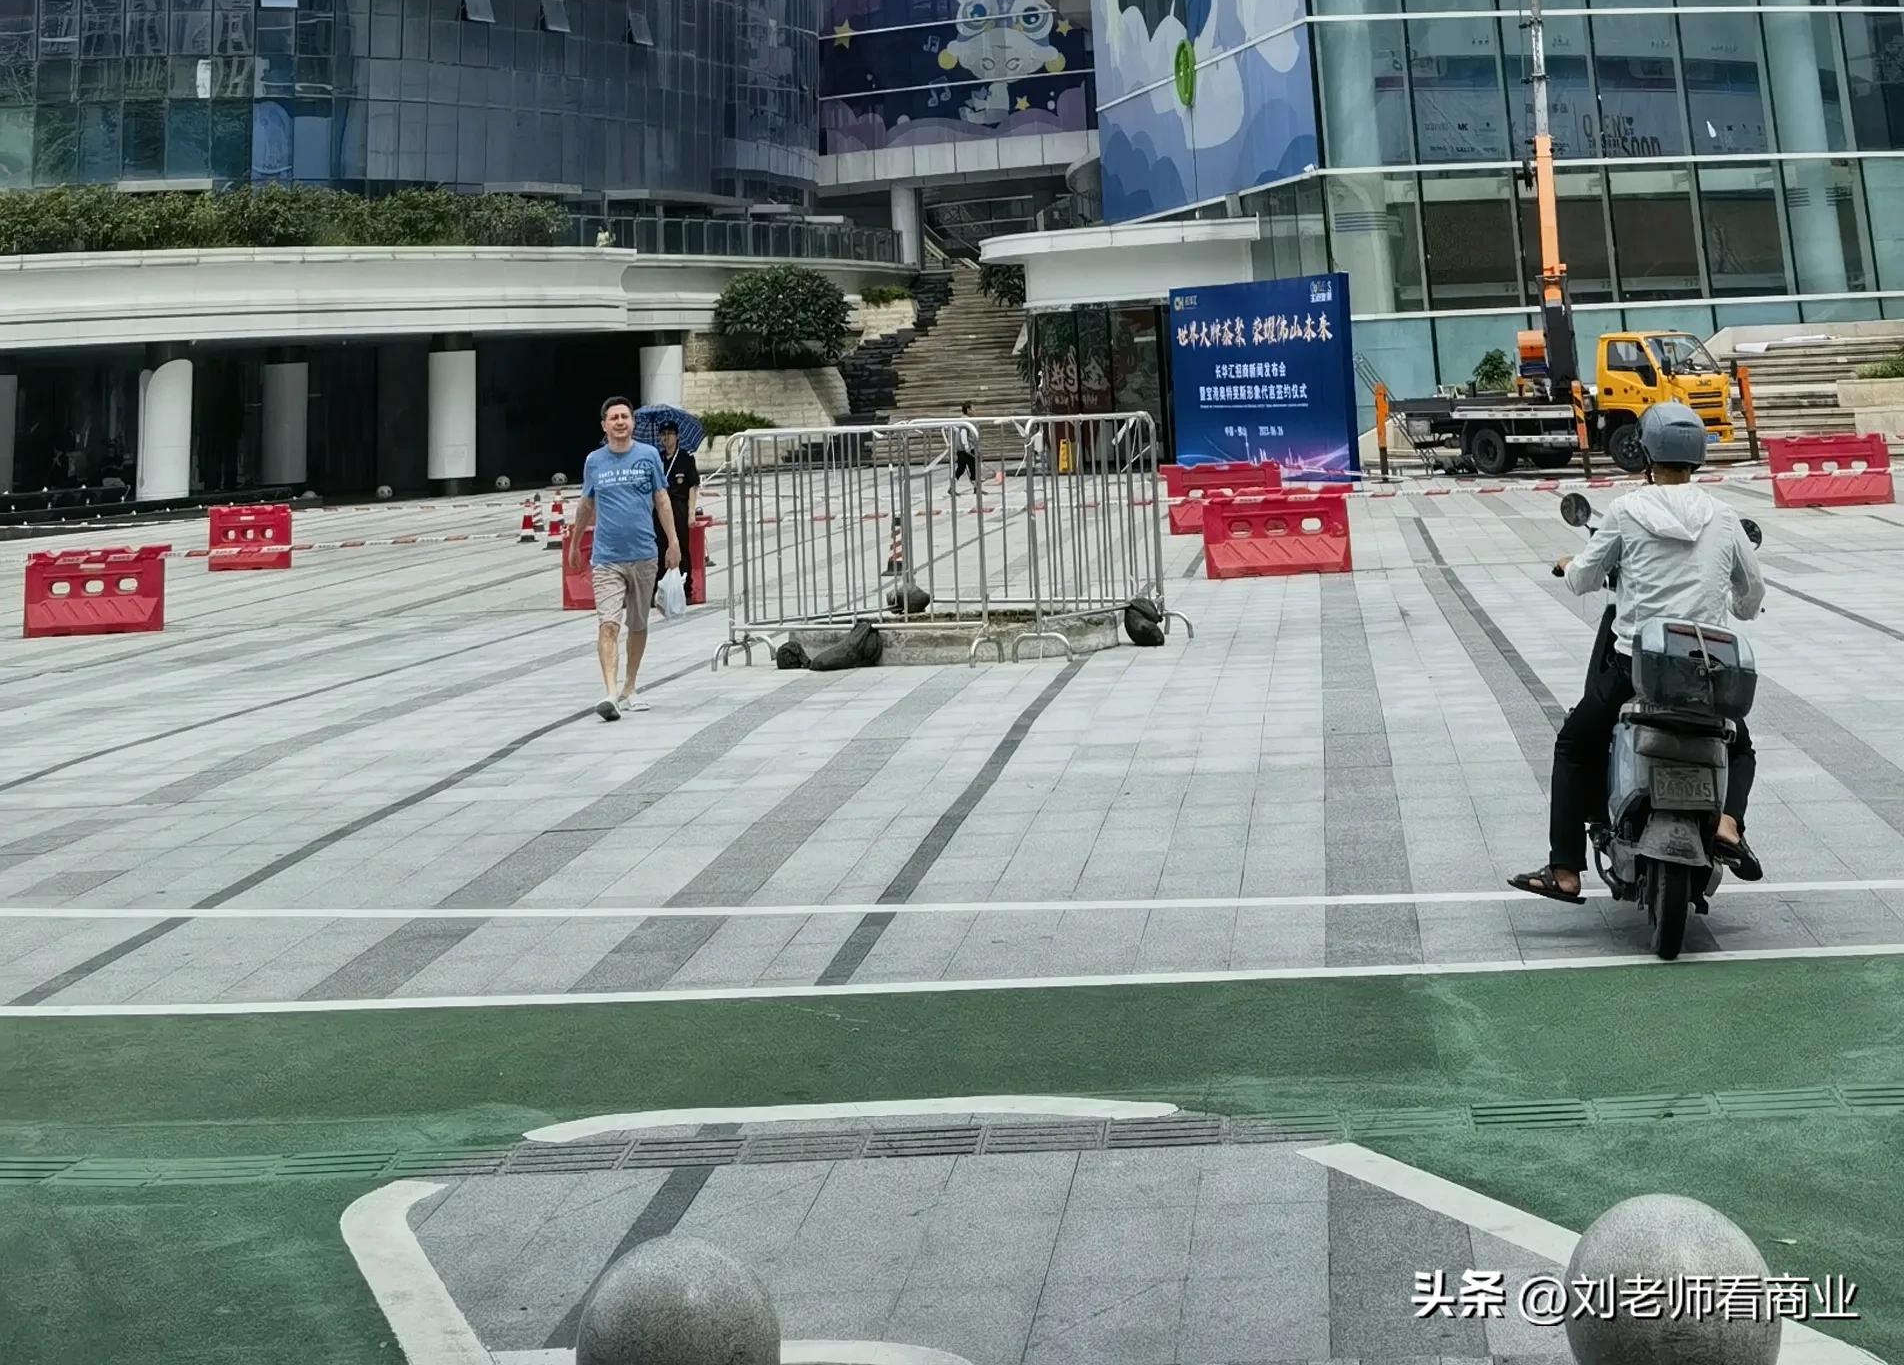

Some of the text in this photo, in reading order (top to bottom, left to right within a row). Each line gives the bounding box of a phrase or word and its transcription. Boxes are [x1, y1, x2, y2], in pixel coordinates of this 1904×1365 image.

[1215, 361, 1287, 379] 长华汇招商新闻发布会
